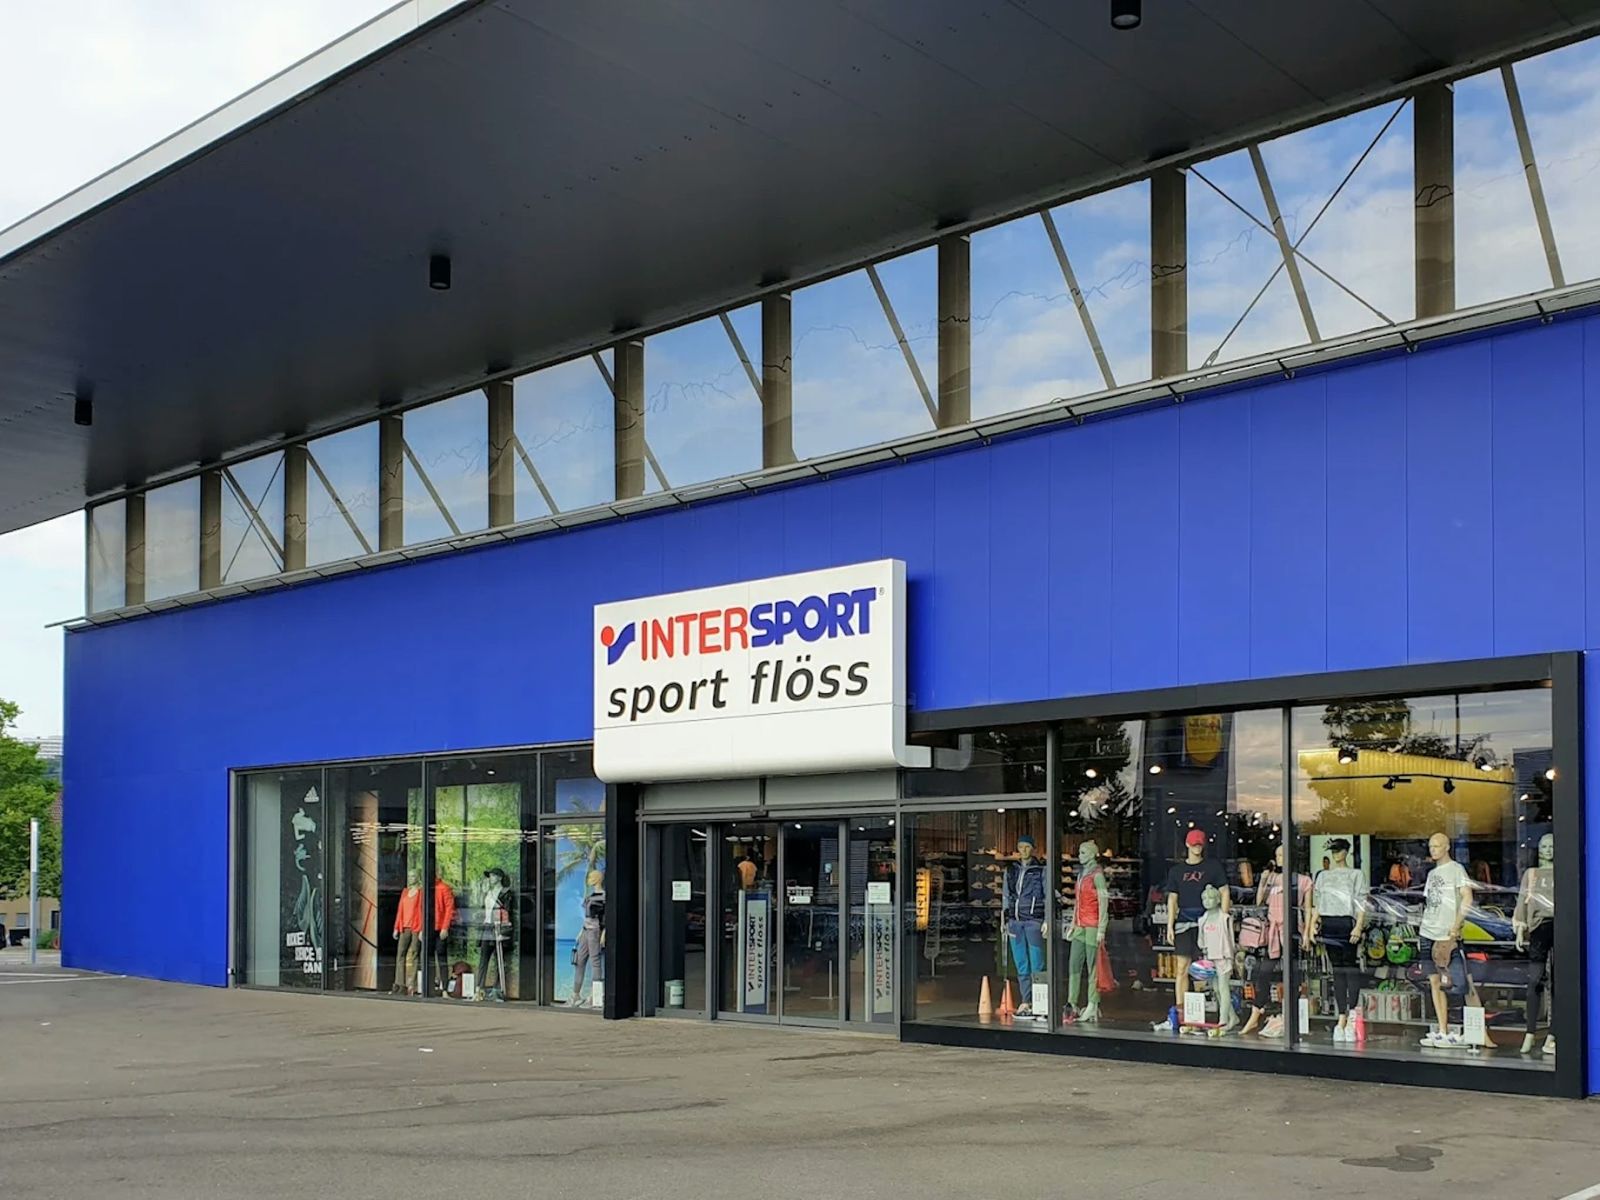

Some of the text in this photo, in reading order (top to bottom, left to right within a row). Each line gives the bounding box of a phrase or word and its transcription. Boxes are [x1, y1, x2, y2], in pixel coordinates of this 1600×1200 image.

[641, 587, 876, 661] INTERSPORT
[608, 654, 870, 721] sport flöss
[748, 913, 756, 980] INTERSPORT
